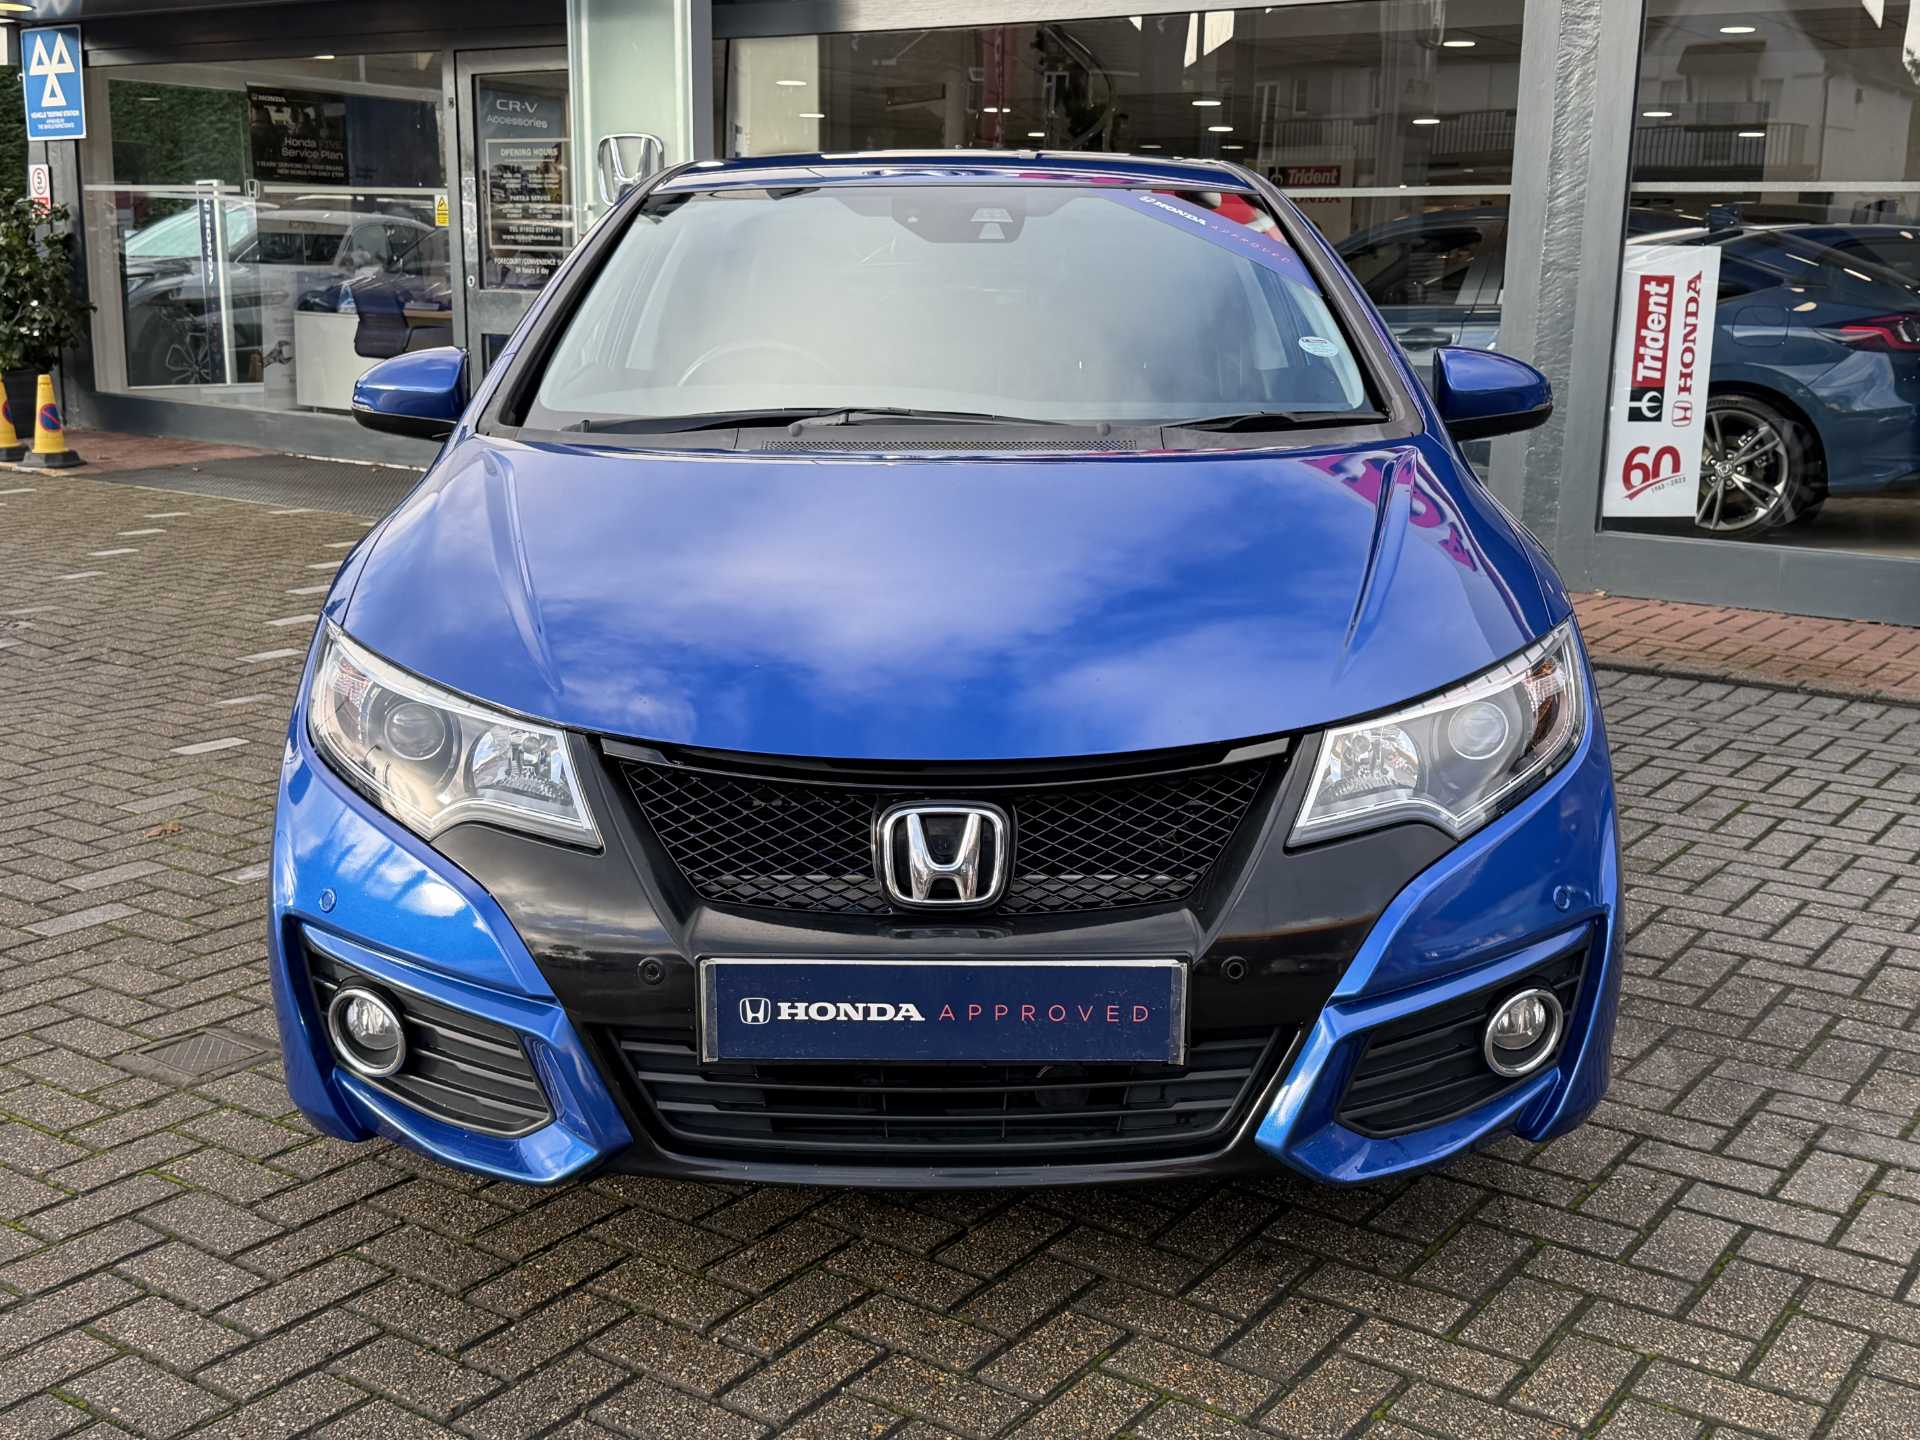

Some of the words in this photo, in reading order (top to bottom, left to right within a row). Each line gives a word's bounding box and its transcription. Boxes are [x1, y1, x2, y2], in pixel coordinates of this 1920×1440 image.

[259, 94, 287, 103] HONDA
[487, 114, 548, 129] Accessories
[284, 136, 317, 148] Honda
[281, 147, 319, 159] Service
[321, 150, 344, 160] Plan
[500, 148, 531, 157] OPENING
[533, 147, 559, 157] HOURS
[36, 172, 43, 185] 5
[1287, 168, 1338, 185] Trident
[1153, 201, 1207, 226] HONDA
[1636, 281, 1670, 382] Trident
[1678, 270, 1703, 395] HONDA
[1622, 445, 1681, 492] 60
[777, 1002, 926, 1021] HONDA
[938, 1004, 1149, 1022] APPROVED
